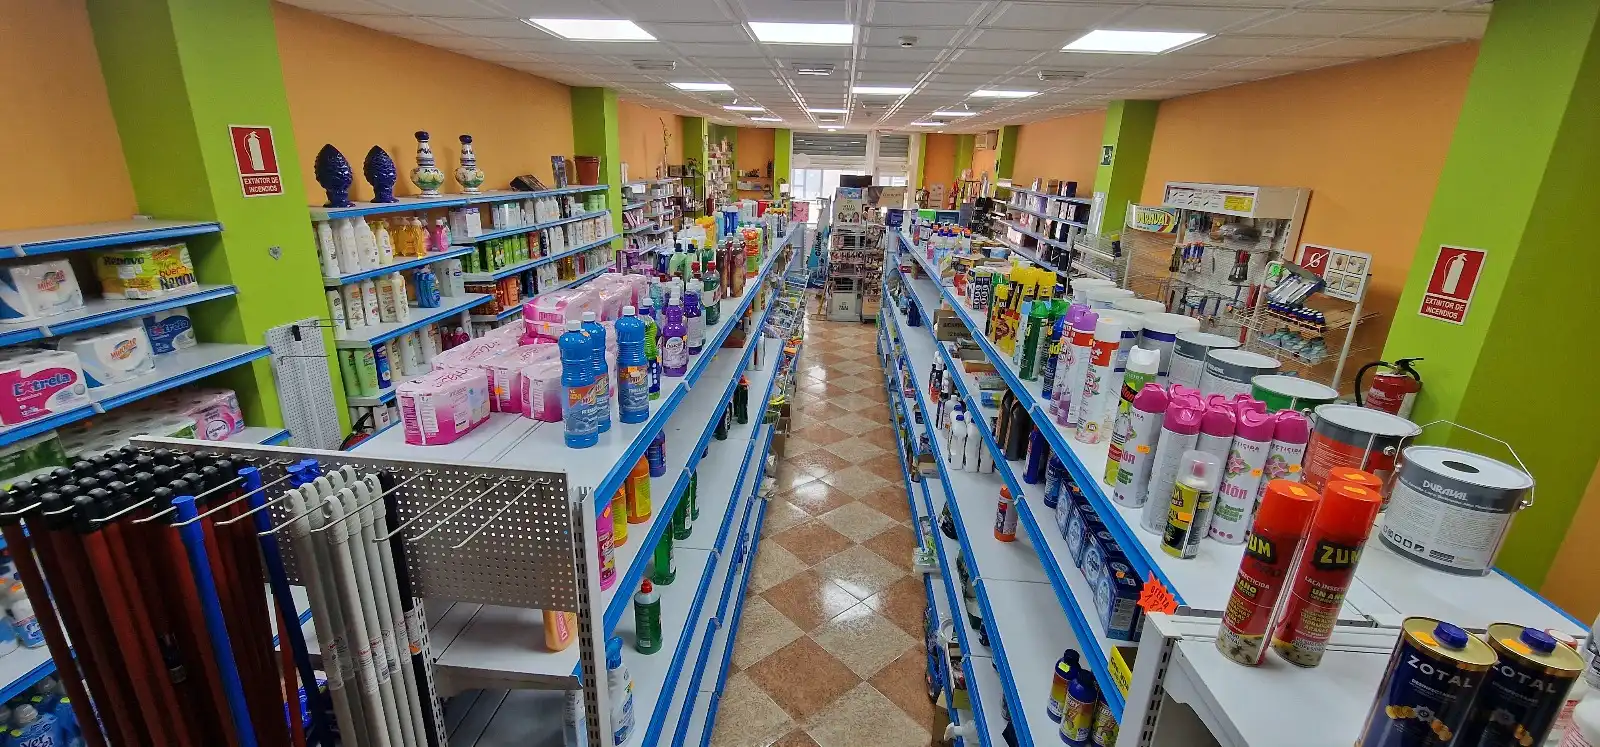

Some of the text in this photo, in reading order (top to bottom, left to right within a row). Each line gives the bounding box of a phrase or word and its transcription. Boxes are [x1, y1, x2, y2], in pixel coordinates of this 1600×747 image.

[244, 176, 279, 185] EXTINTOR DE
[249, 185, 278, 193] INCENDIOS
[815, 231, 823, 257] Gillette
[1425, 297, 1465, 312] EXTINTOR DE
[1425, 306, 1459, 319] INCENDIOS
[13, 372, 72, 396] Extrela
[1422, 480, 1469, 501] DURAVAL
[1248, 533, 1271, 558] UM
[1150, 585, 1170, 609] OFERTA
[1407, 654, 1474, 689] ZOTAL
